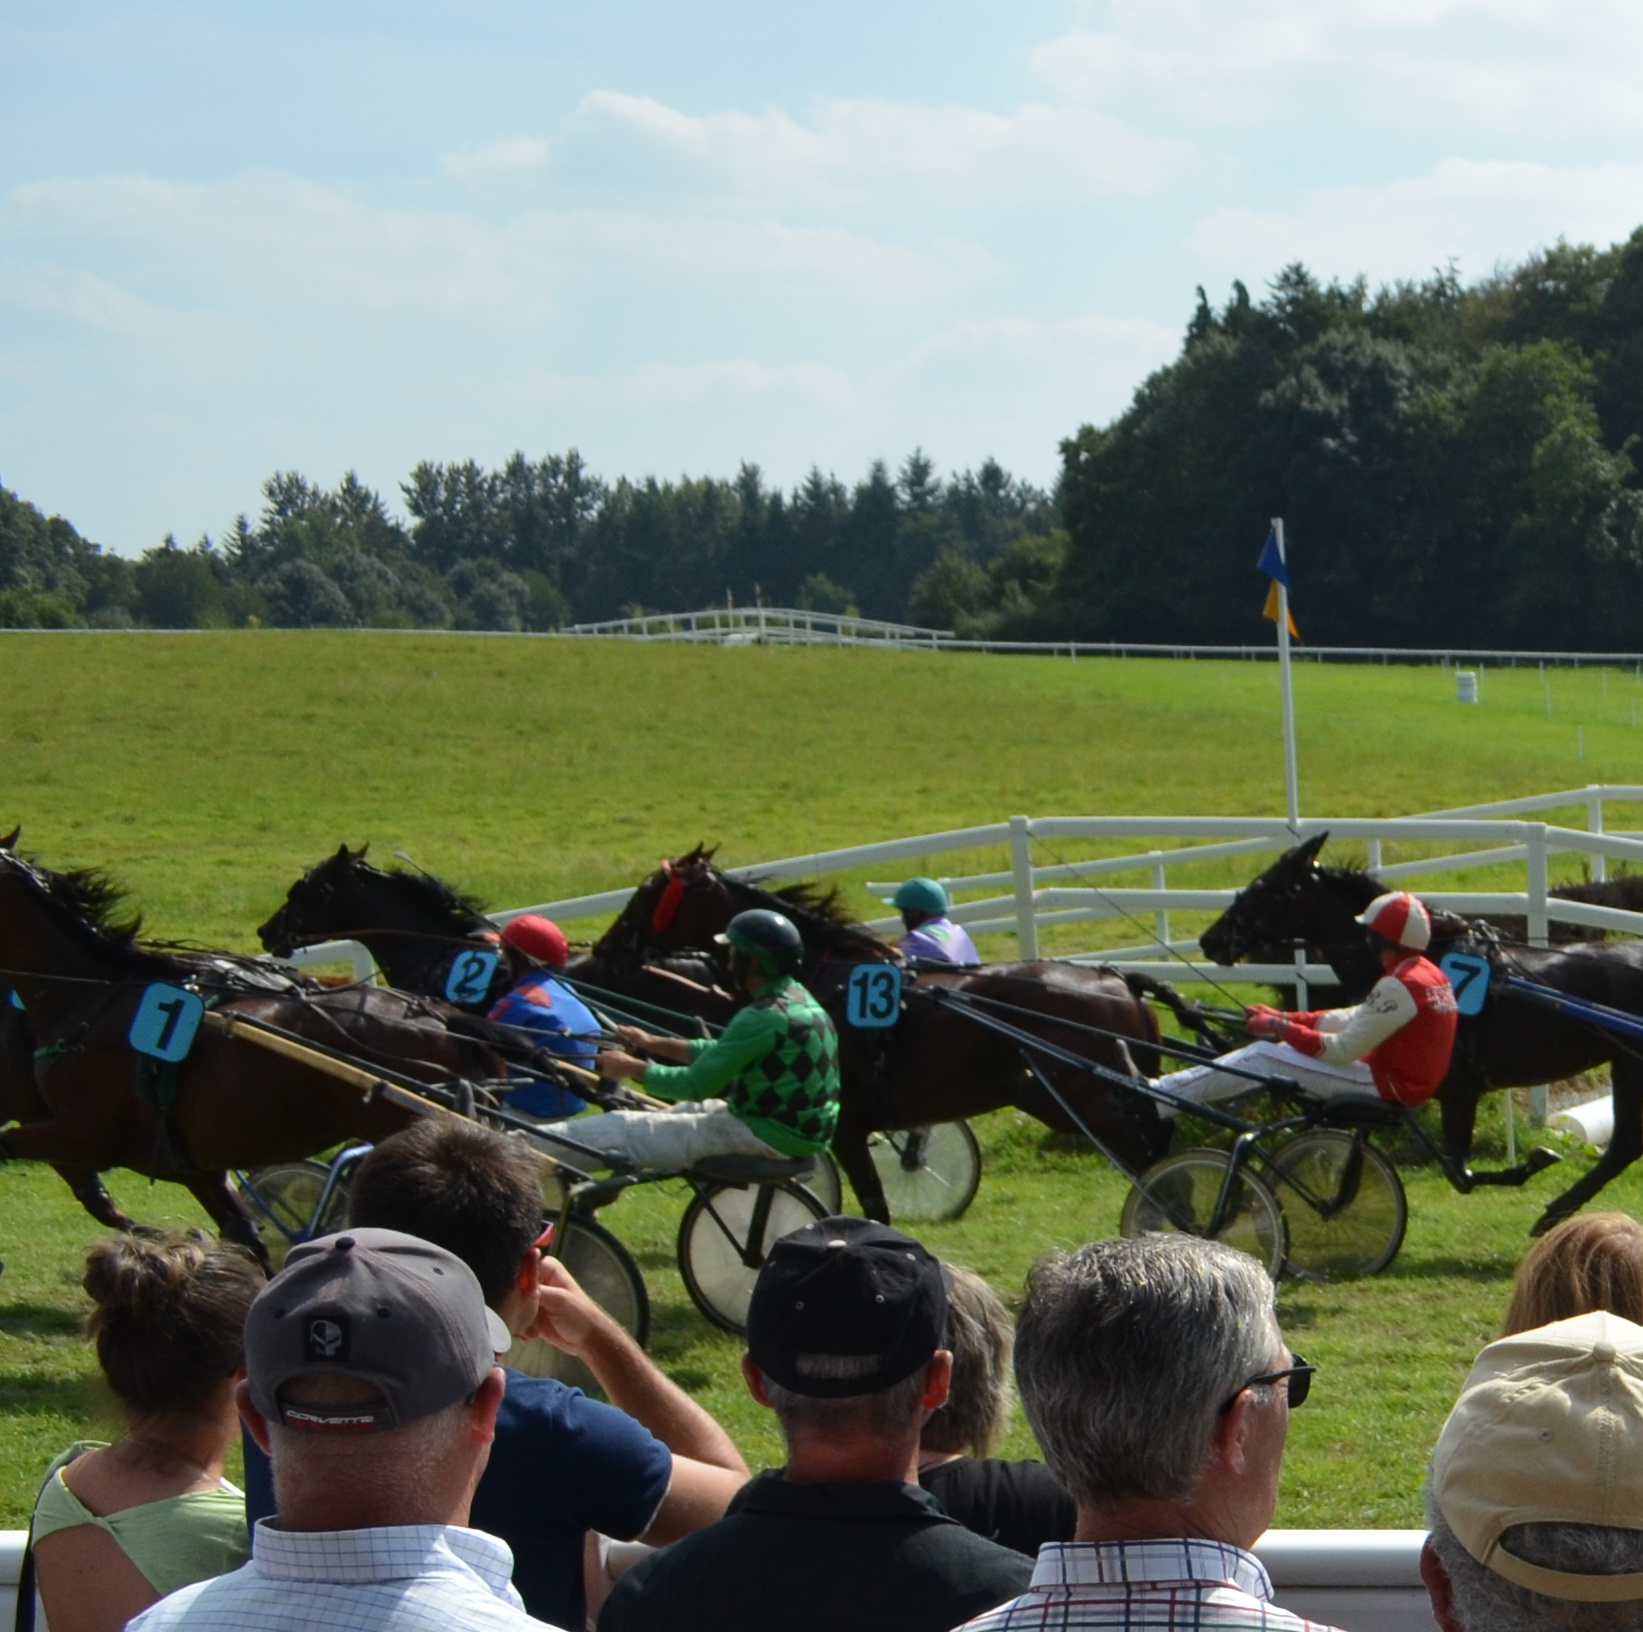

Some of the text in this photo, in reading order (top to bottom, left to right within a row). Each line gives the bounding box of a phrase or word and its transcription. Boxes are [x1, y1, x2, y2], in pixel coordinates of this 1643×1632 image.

[453, 955, 487, 995] 2
[852, 971, 895, 1019] 13
[1450, 961, 1482, 1001] 7
[157, 999, 186, 1051] 1
[286, 1409, 374, 1425] CORVETTE
